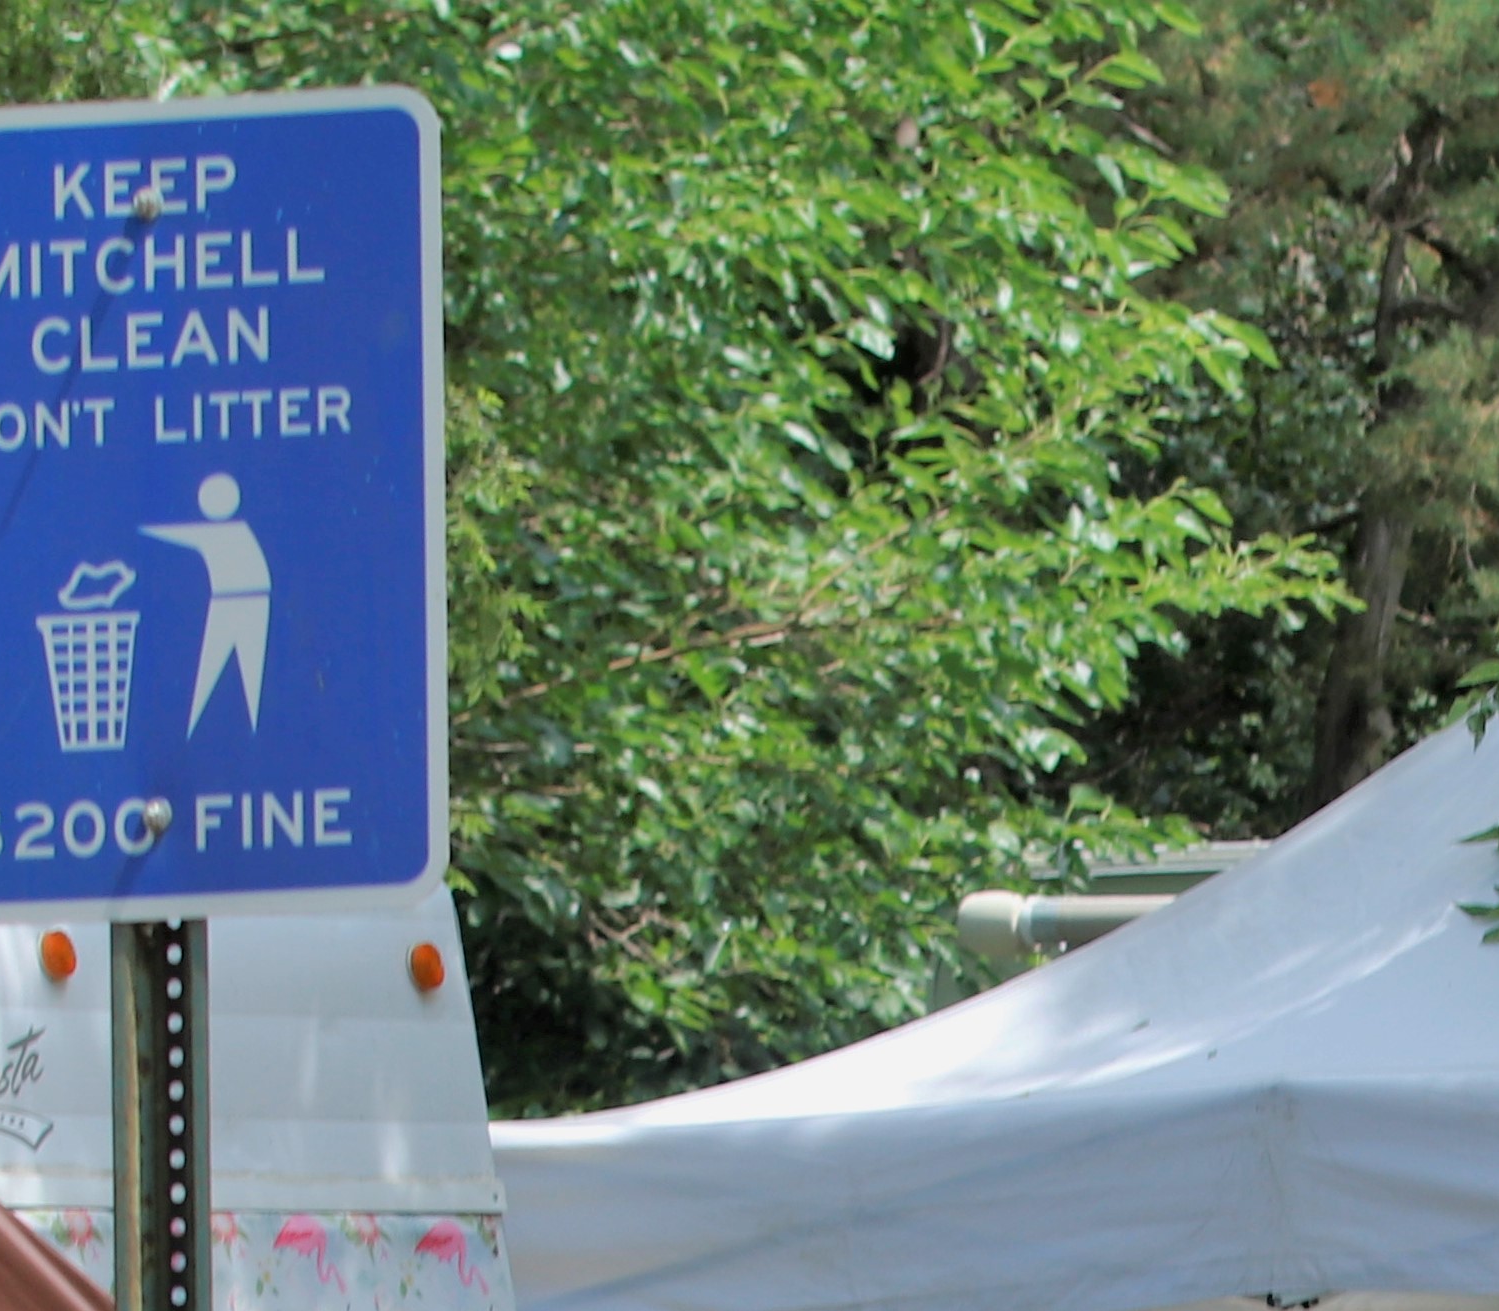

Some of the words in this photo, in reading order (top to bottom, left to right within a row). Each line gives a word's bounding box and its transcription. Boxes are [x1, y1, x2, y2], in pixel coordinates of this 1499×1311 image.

[53, 155, 237, 220] KEEP
[32, 306, 269, 374] CLEAN
[154, 386, 352, 444] LITTER
[196, 789, 352, 852] FINE
